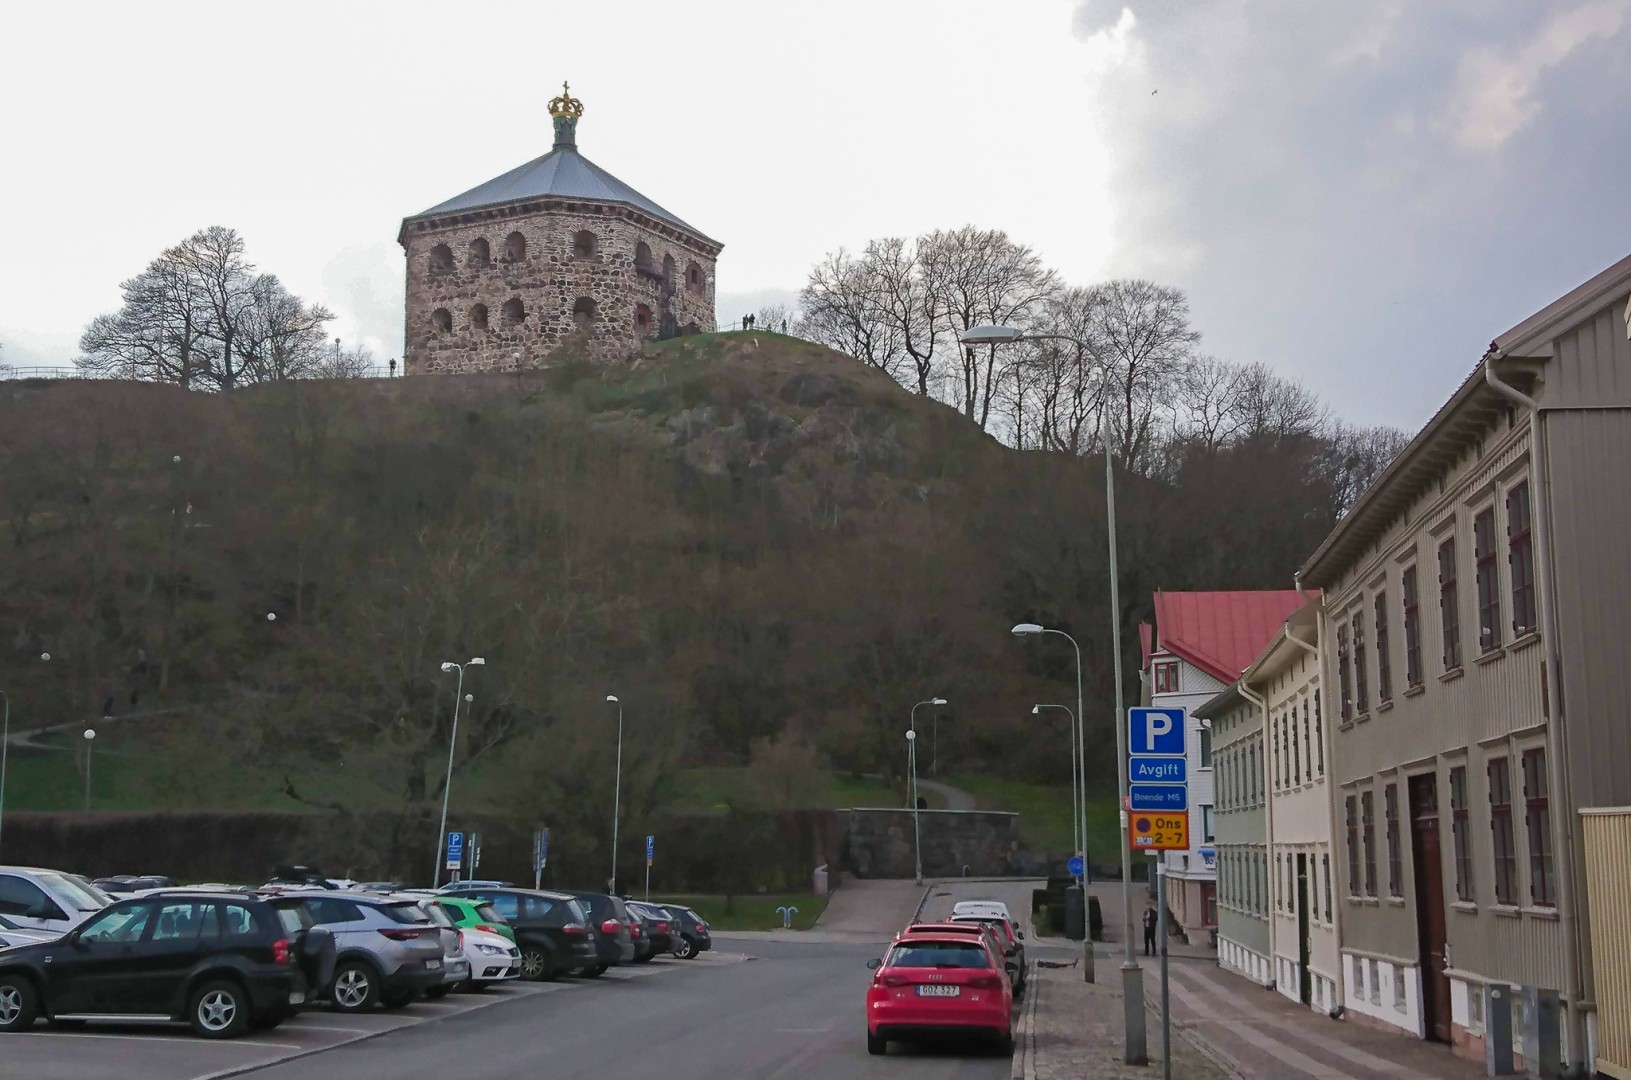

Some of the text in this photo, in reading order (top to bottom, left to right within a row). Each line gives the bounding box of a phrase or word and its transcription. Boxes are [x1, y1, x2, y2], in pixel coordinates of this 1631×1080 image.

[1146, 712, 1173, 751] P
[1138, 763, 1179, 778] Avgift
[1134, 793, 1163, 801] Boende
[1155, 818, 1181, 829] Ons
[452, 834, 460, 845] P
